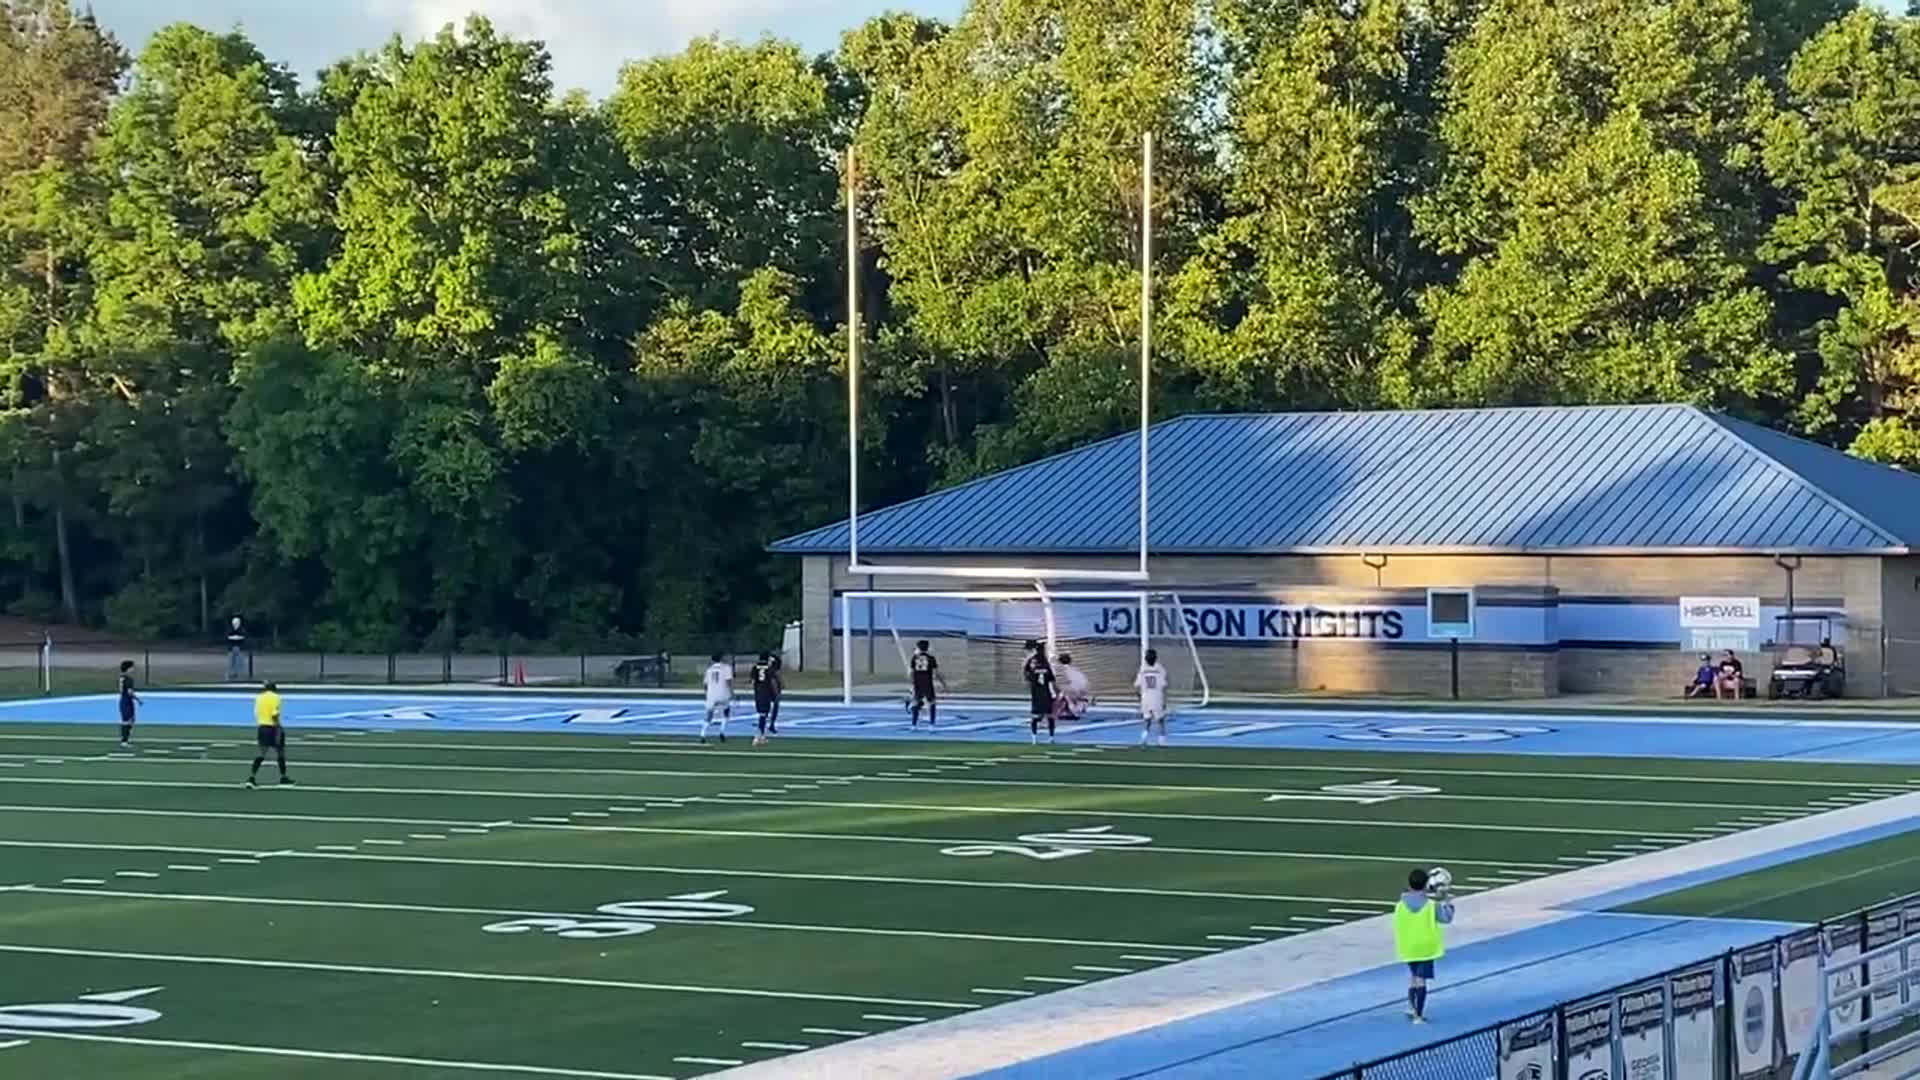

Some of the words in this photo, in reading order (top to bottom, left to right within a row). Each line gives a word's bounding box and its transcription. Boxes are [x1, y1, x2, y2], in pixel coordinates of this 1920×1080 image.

[1258, 609, 1403, 640] KNIGHTS
[940, 831, 1152, 860] 20
[481, 898, 756, 939] 30
